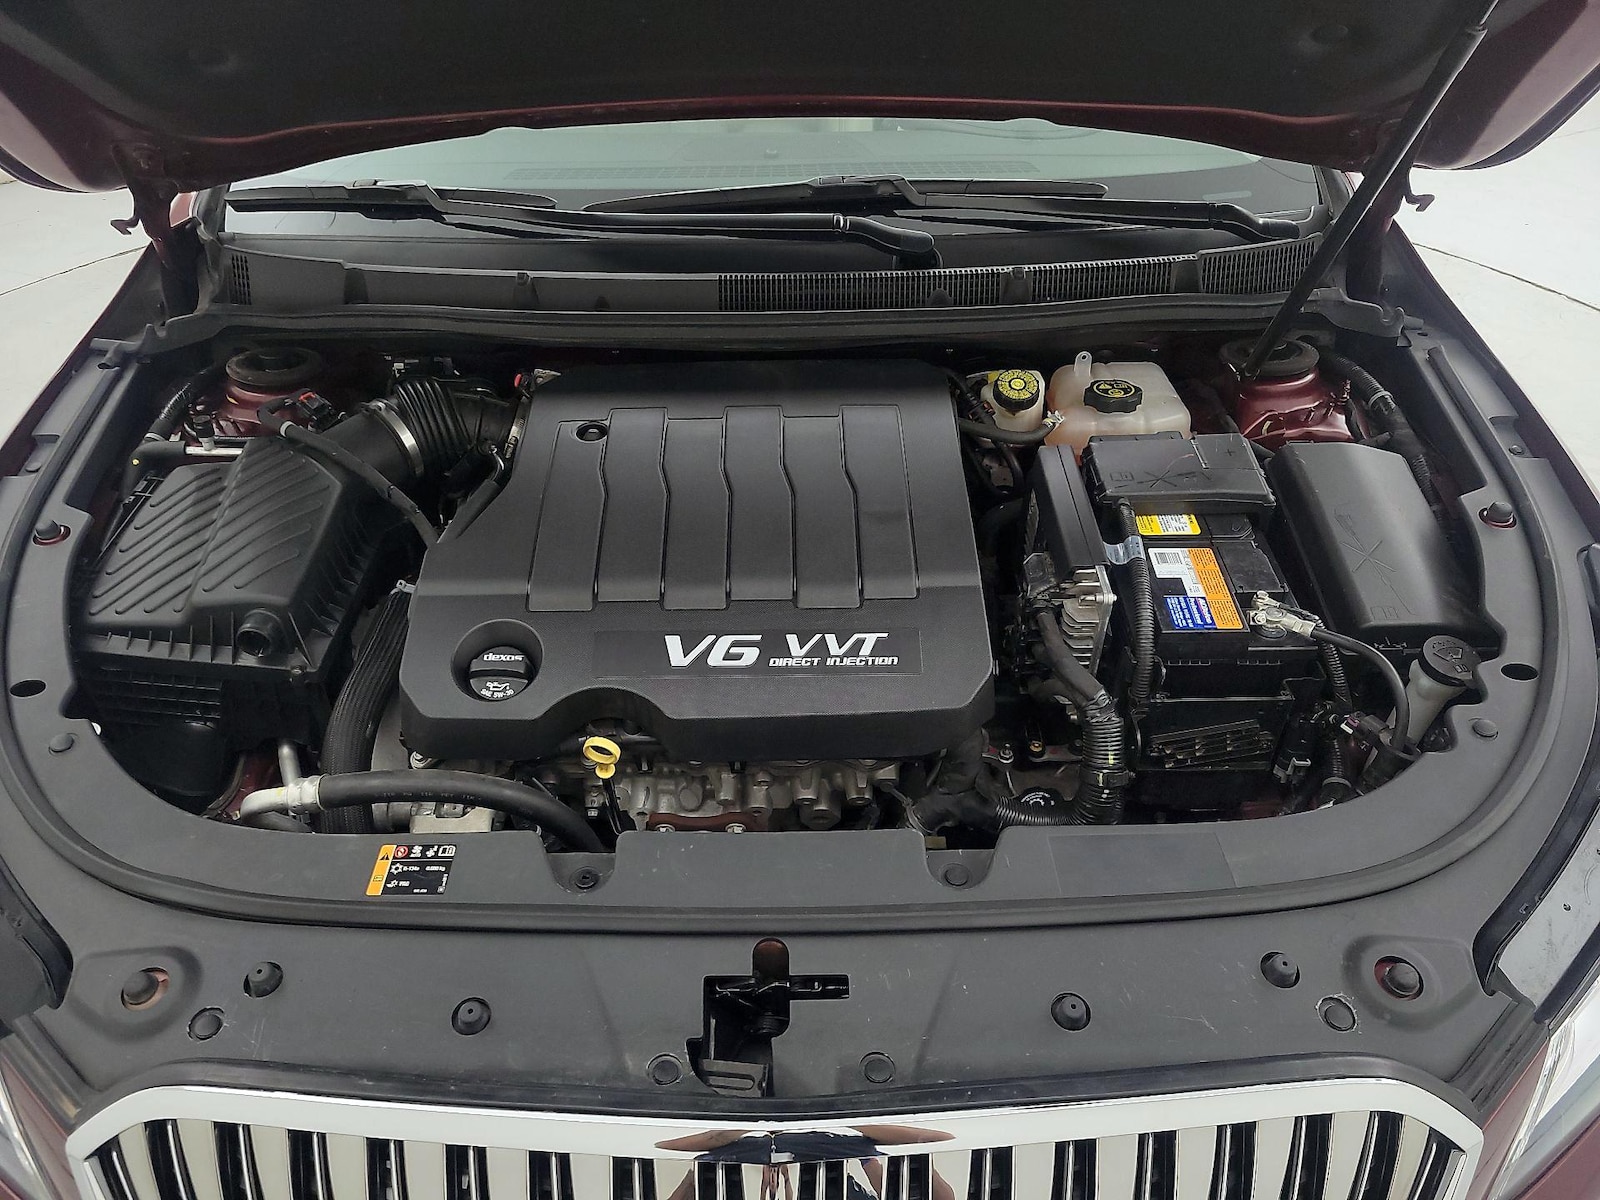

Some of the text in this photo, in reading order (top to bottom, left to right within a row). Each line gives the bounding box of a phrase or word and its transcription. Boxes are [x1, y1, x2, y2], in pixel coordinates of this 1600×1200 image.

[664, 632, 890, 668] V6 VVT
[483, 653, 525, 661] dexos
[768, 656, 899, 667] DIRECT INJECTION
